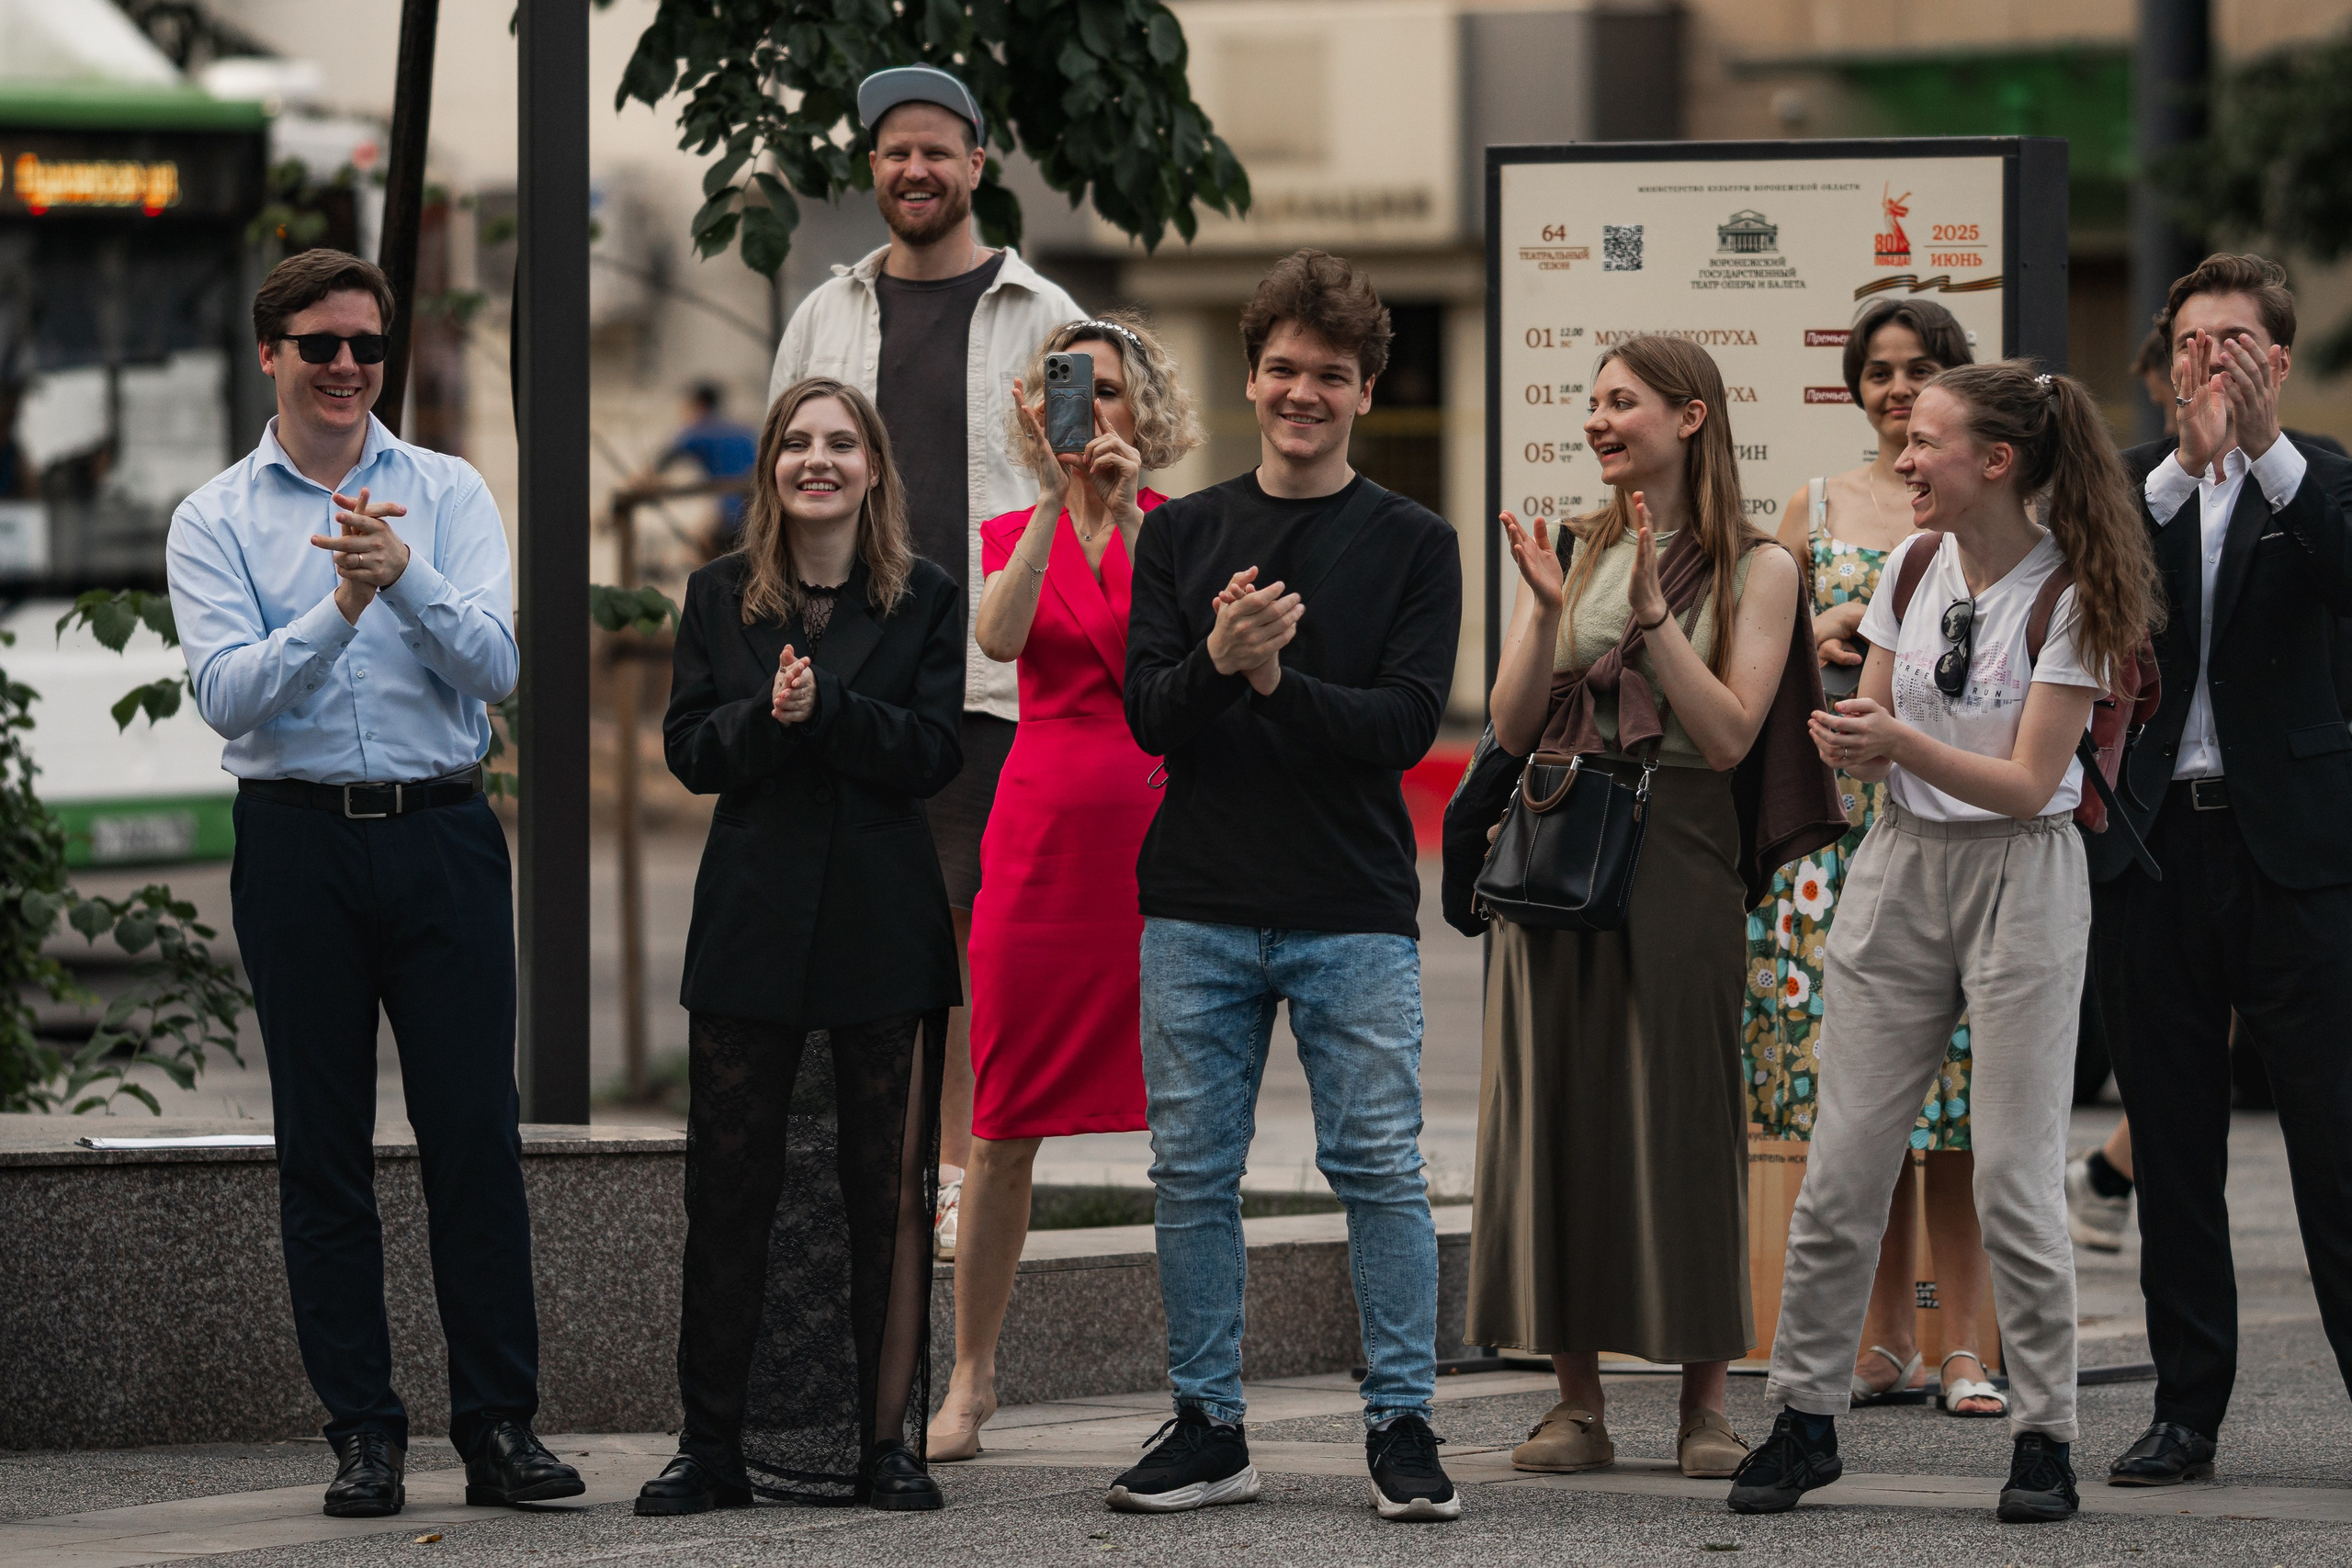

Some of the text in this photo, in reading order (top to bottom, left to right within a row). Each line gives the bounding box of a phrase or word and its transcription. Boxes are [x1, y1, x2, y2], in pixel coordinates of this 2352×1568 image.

[1542, 224, 1566, 242] 64
[1932, 224, 1980, 241] 2025
[1875, 232, 1894, 253] 80
[1519, 249, 1589, 260] ТЕАТРАЛЬНЫЙ
[1709, 256, 1786, 266] ВОРОНЕЖСКИЙ
[1930, 253, 1983, 267] ИЮНЬ
[1538, 262, 1570, 270] СЕЗОН
[1699, 268, 1796, 278] ГОСУДАРСТВЕННЫЙ
[1690, 279, 1806, 288] ТЕАТР ОПЕРЫ И БАЛЕТА
[1525, 328, 1555, 348] 01
[1524, 384, 1554, 405] 01
[1524, 443, 1555, 463] 05
[1523, 496, 1554, 516] 08
[1972, 687, 2002, 698] RUN
